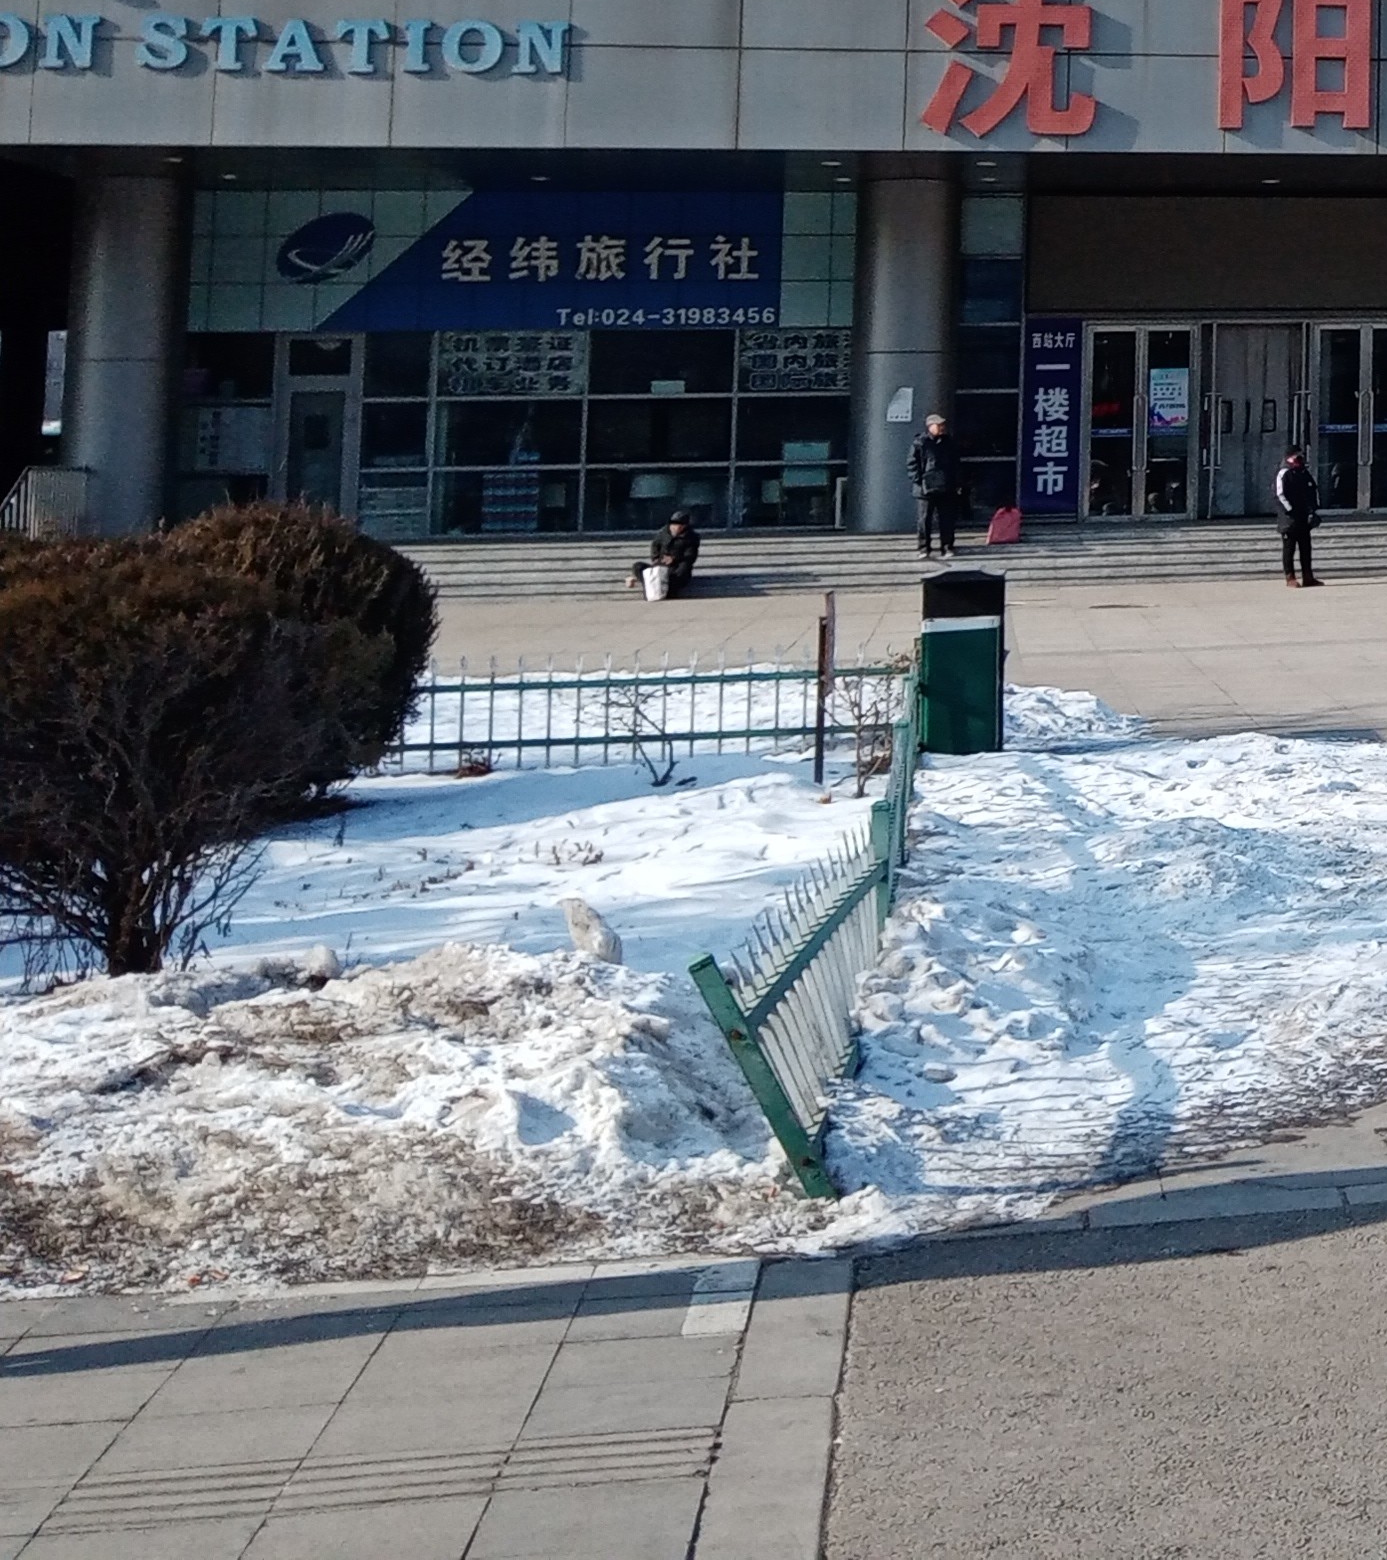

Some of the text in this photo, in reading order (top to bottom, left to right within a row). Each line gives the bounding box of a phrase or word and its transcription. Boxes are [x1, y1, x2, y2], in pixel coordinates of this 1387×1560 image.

[135, 15, 572, 75] STATION
[441, 235, 760, 283] 经纬旅行社
[1032, 332, 1076, 349] 西站大厅
[1033, 363, 1071, 495] 一楼超市
